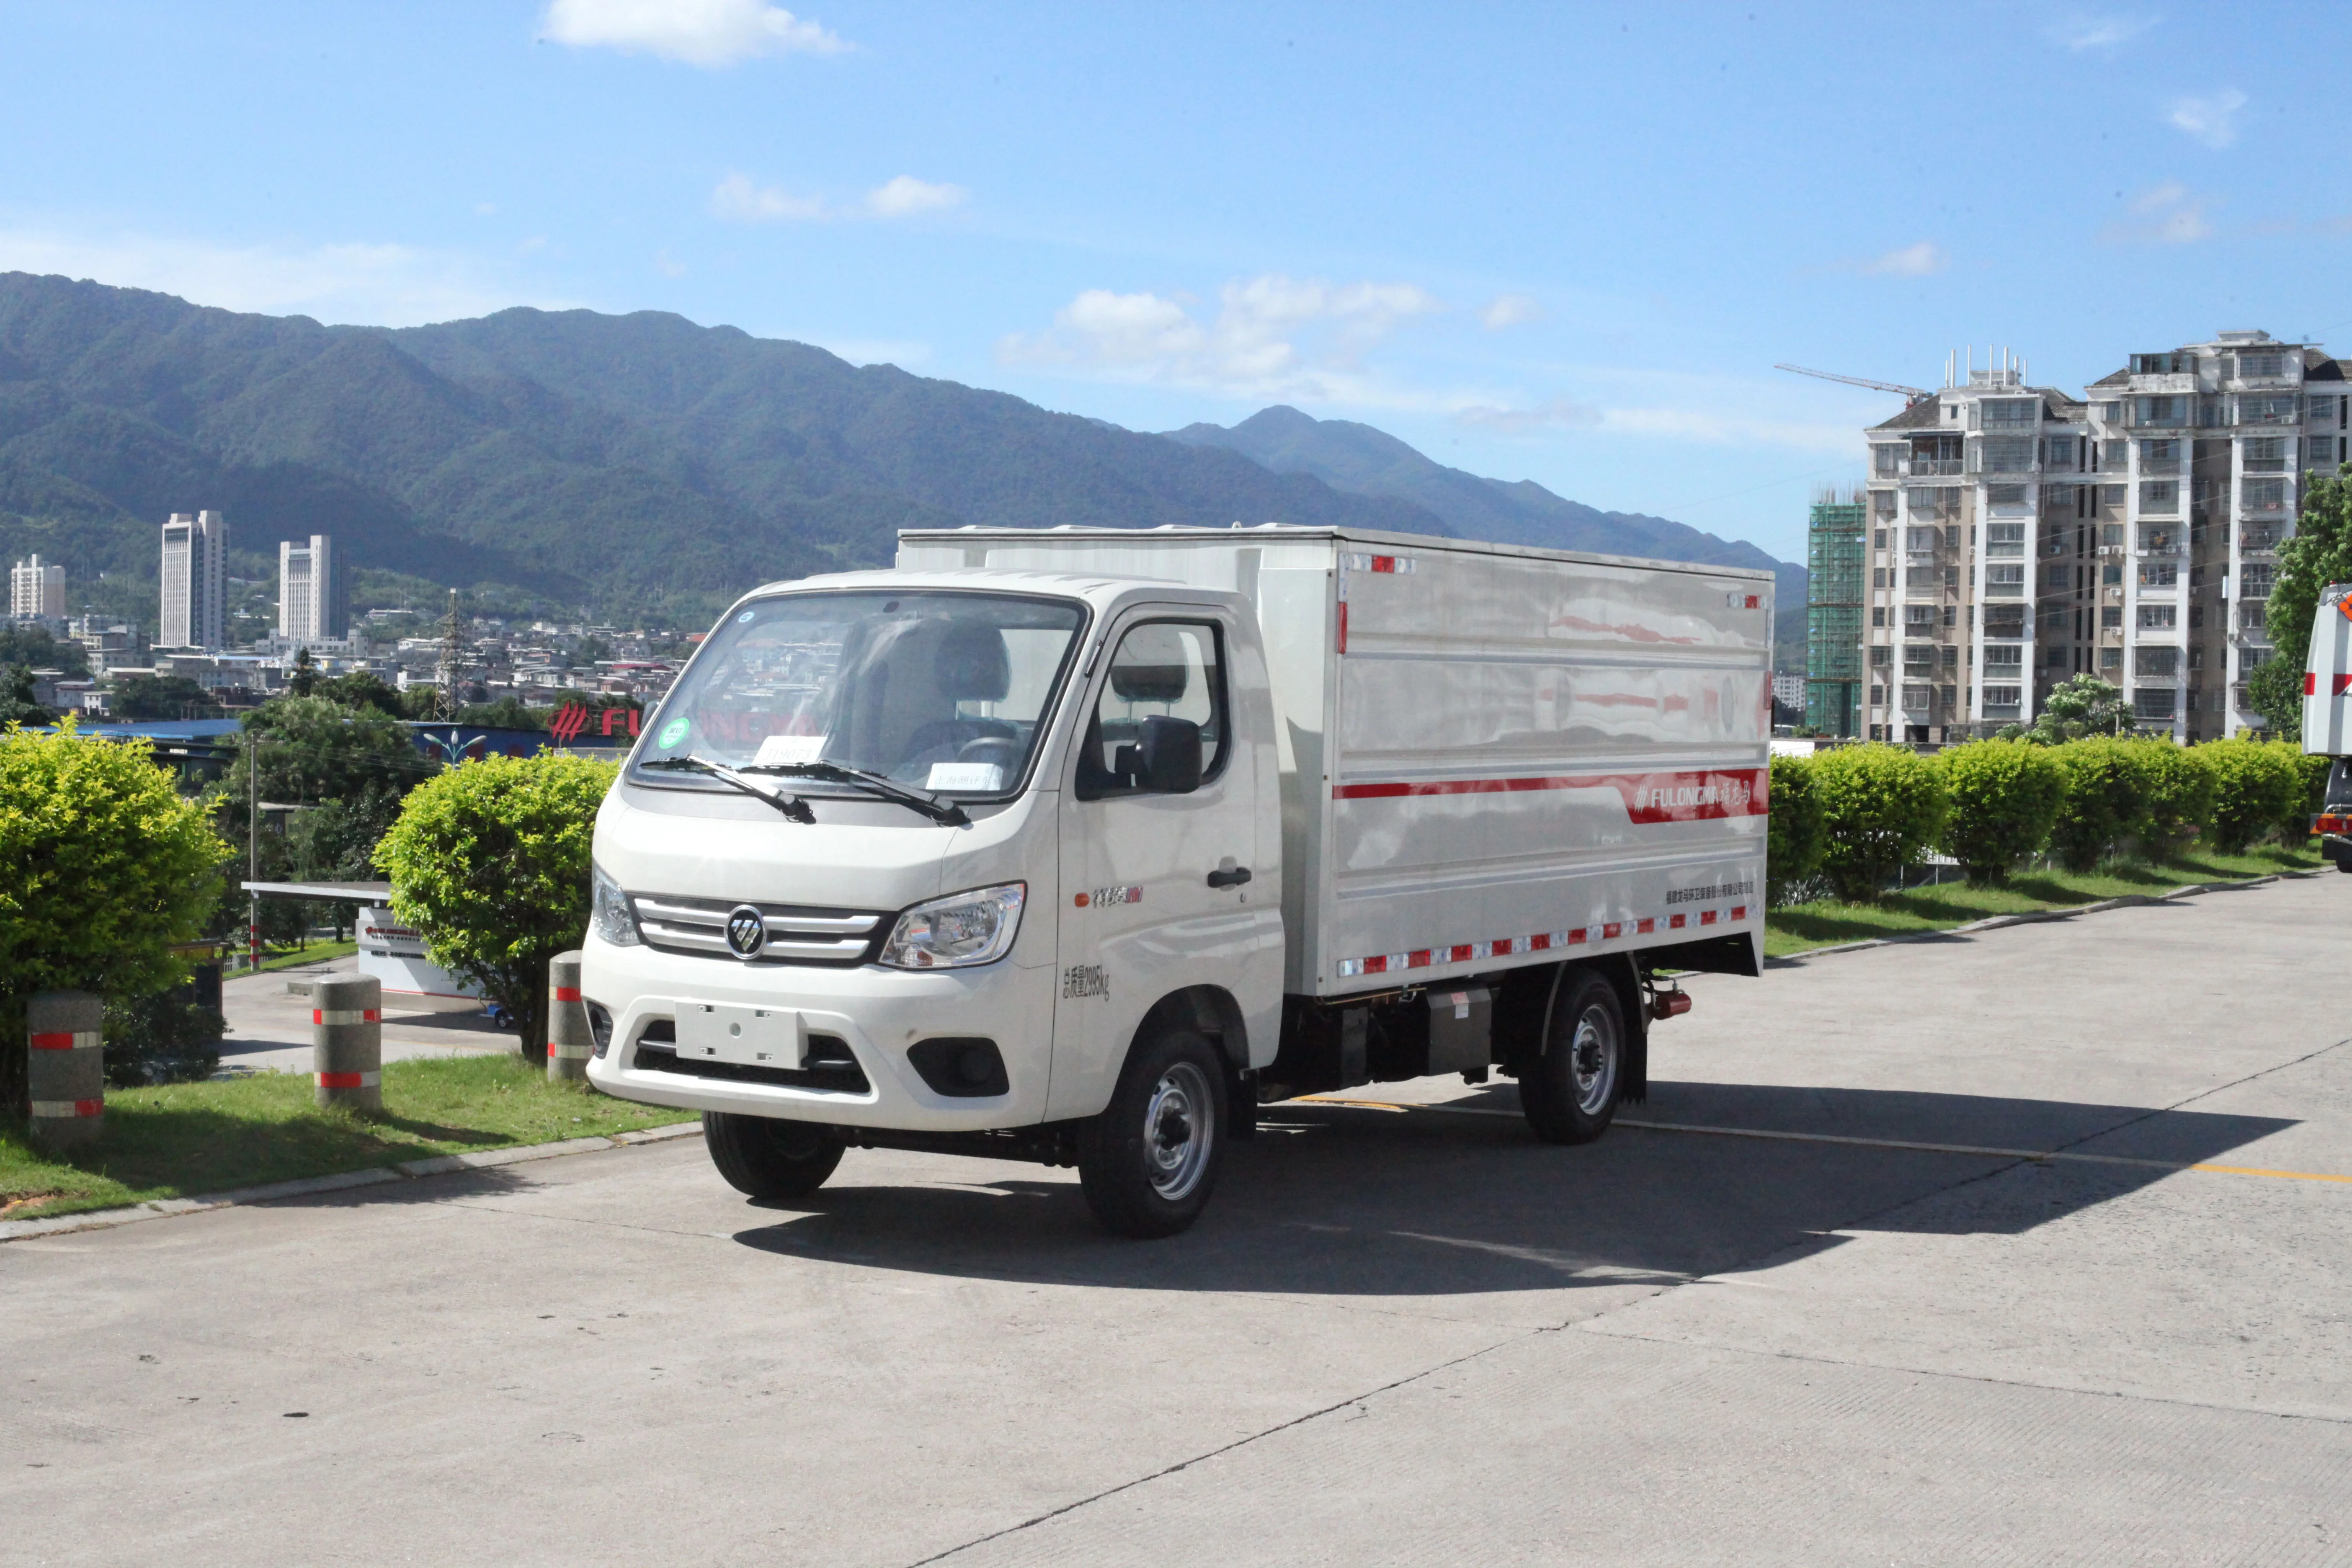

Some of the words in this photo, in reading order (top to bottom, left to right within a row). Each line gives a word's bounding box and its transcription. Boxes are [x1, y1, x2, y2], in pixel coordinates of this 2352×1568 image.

[1651, 786, 1719, 808] FULONGMA
[1720, 780, 1751, 805] 福龙马
